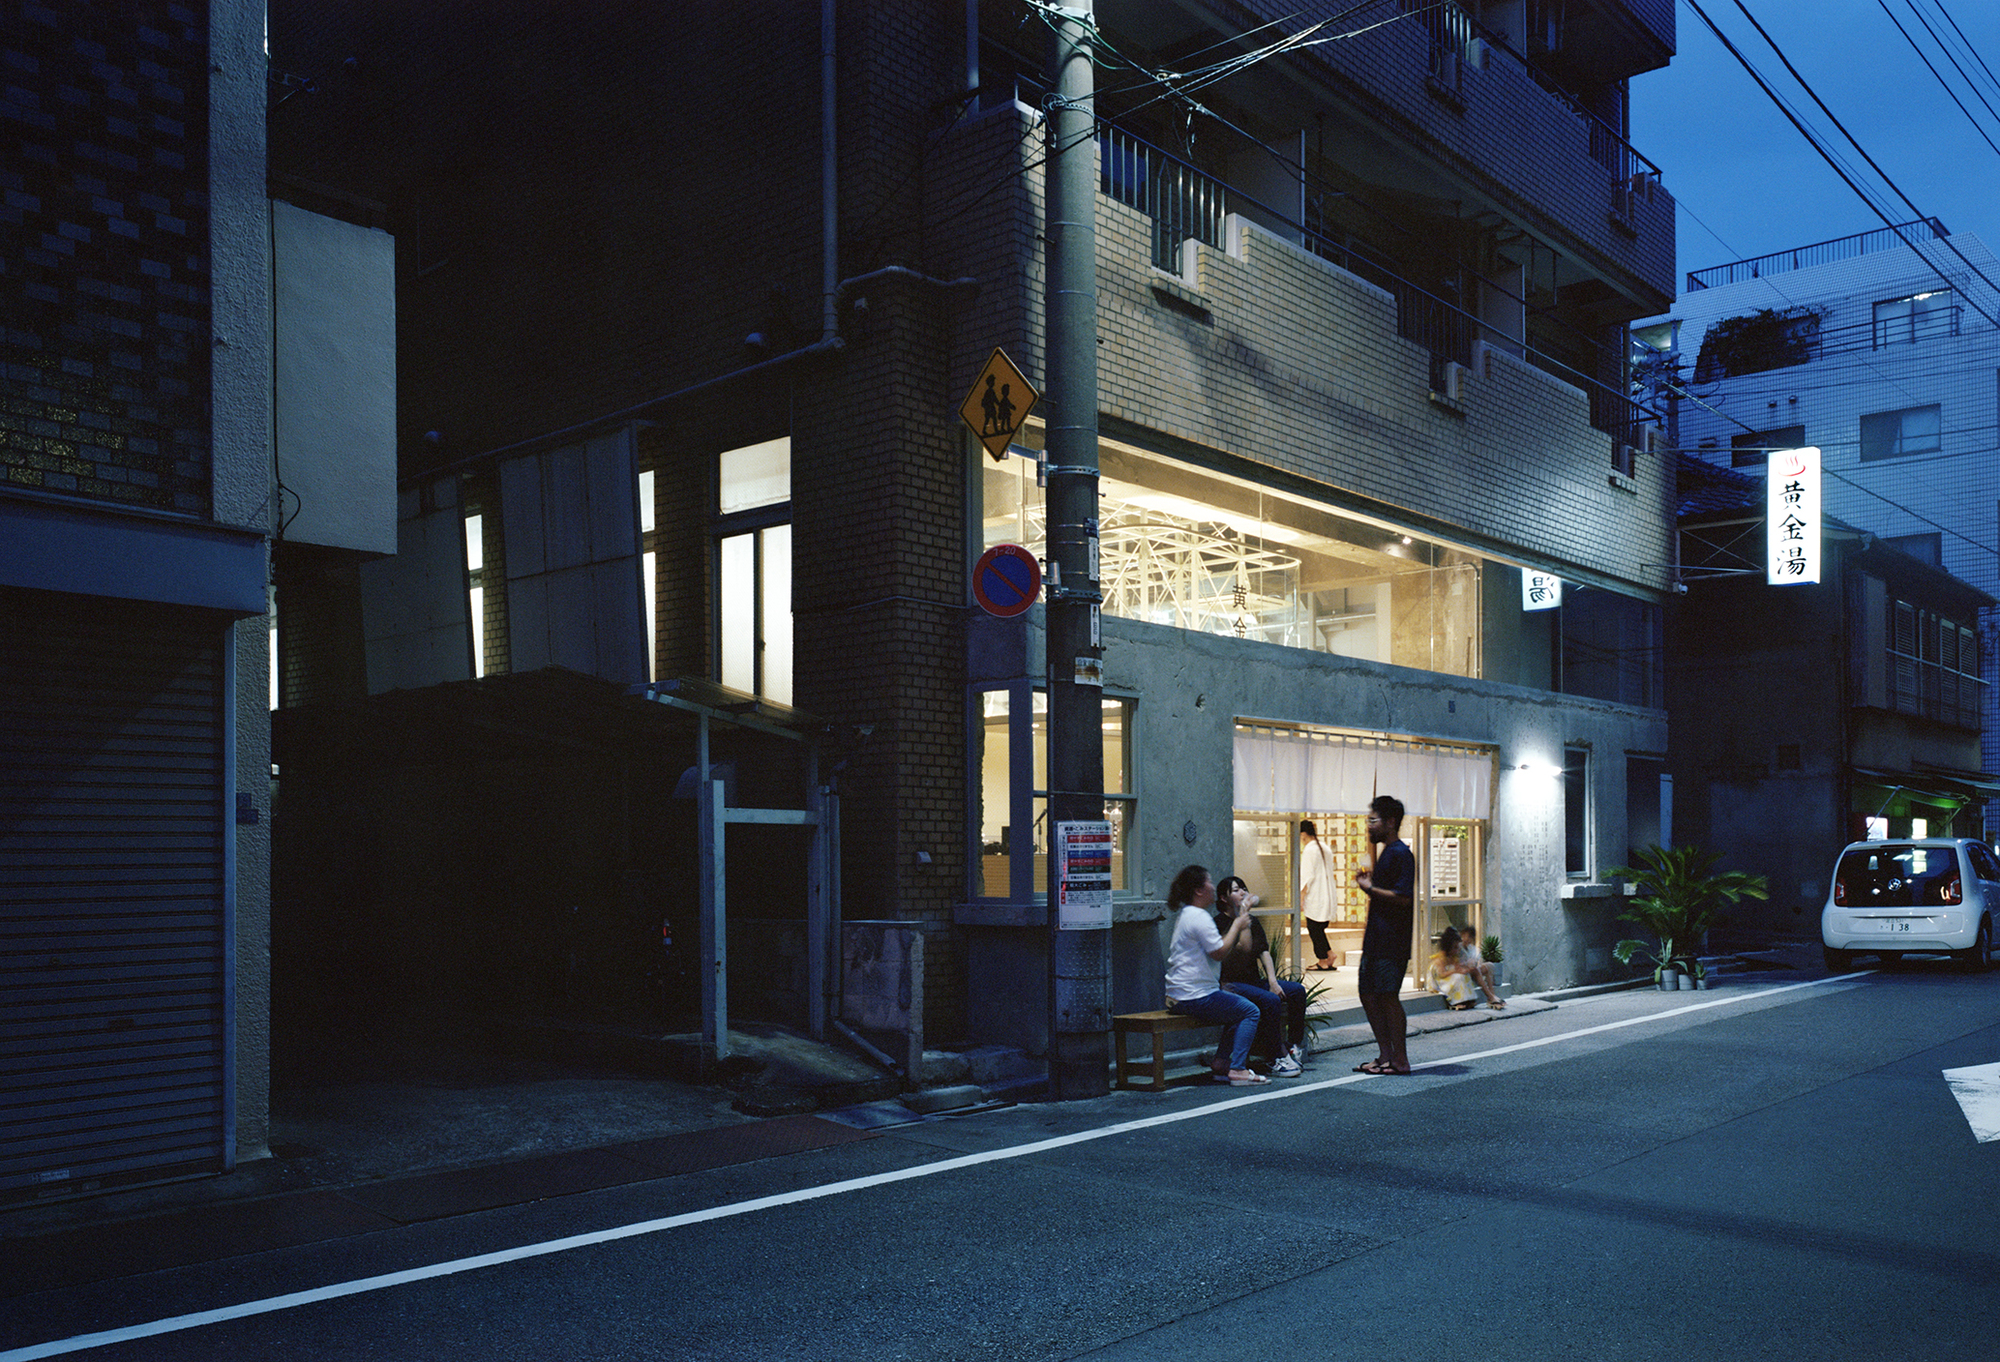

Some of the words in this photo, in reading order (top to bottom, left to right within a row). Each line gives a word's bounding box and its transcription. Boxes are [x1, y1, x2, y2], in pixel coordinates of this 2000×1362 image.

[993, 546, 1016, 556] 7-20
[1776, 480, 1807, 575] 黄金湯
